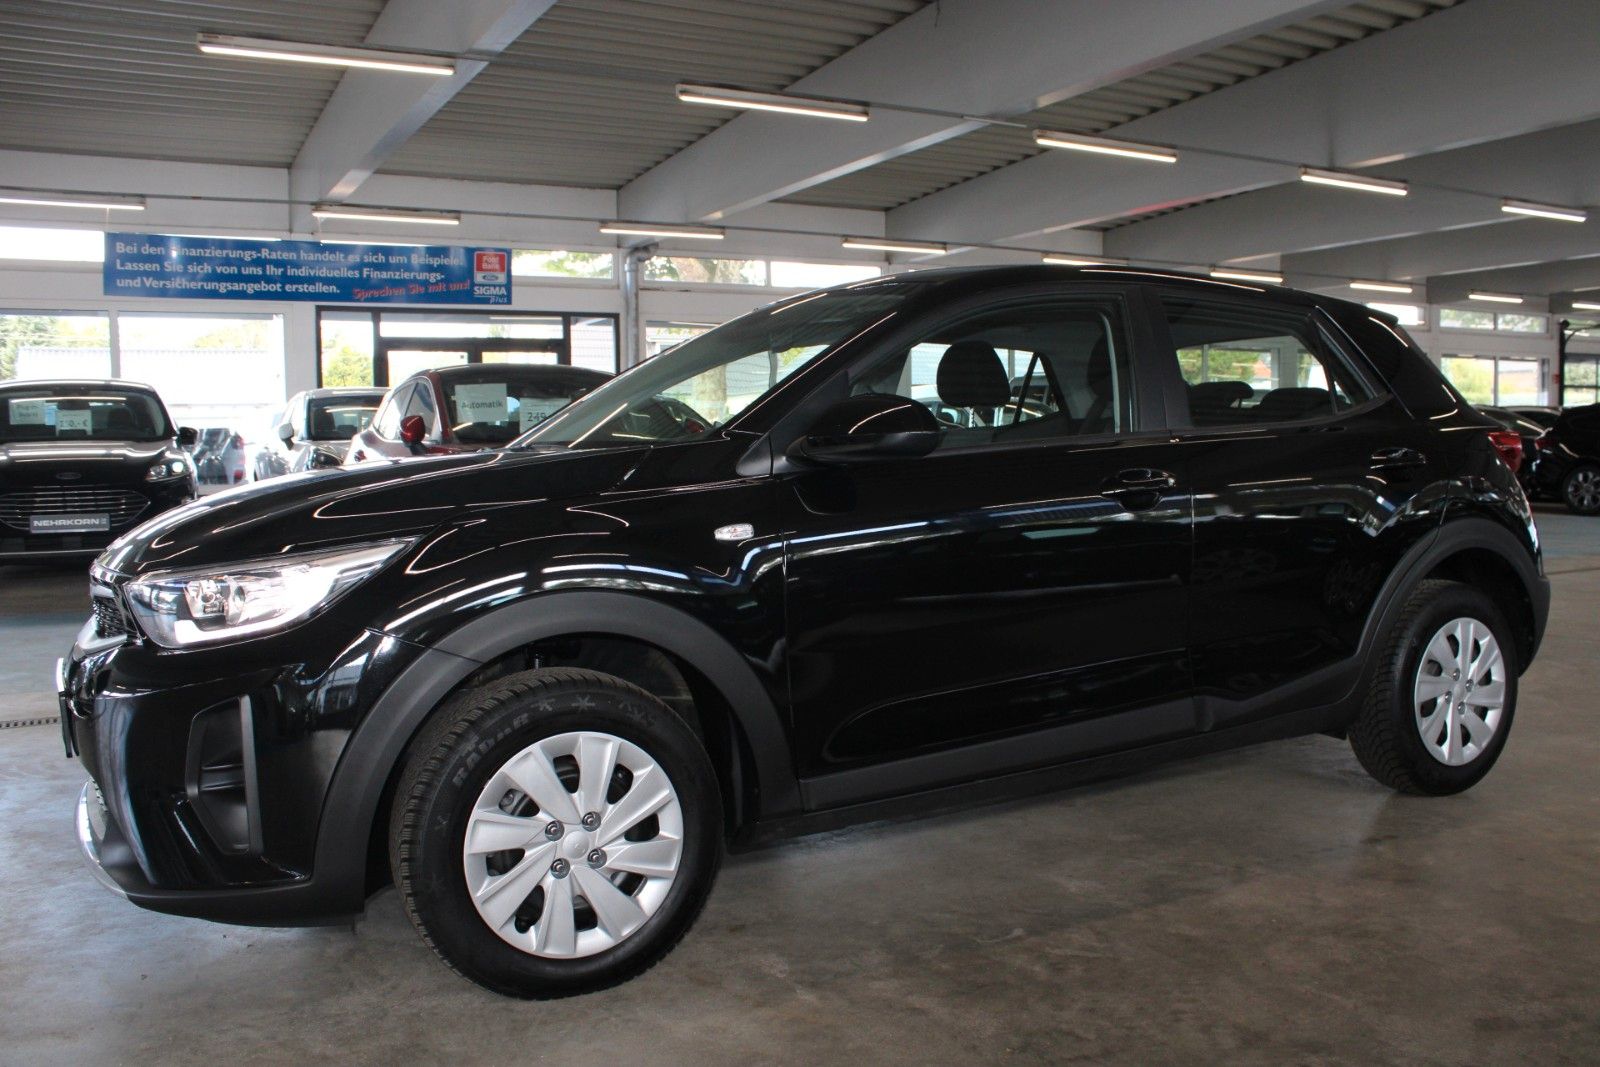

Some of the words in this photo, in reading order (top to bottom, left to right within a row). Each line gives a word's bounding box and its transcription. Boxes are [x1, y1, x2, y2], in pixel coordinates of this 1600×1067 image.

[116, 242, 137, 254] Bei
[141, 244, 165, 255] den
[170, 246, 296, 262] inanzierungs-Raten
[300, 250, 345, 262] handelt
[347, 254, 360, 263] es
[363, 252, 386, 264] sich
[389, 255, 408, 264] um
[116, 259, 160, 272] Lassen
[164, 260, 184, 273] Sie
[187, 262, 211, 274] sich
[215, 266, 238, 275] von
[241, 266, 262, 275] uns
[266, 264, 284, 276] Ihr
[287, 265, 360, 279] individuelles
[362, 267, 445, 283] Finanzierungs-
[116, 277, 141, 288] und
[143, 277, 282, 294] Versicherungsangebot
[284, 281, 341, 294] erstellen.
[352, 286, 406, 301] Sprechen
[408, 283, 425, 295] Sie
[428, 281, 446, 293] mit
[449, 279, 471, 292] uns!
[473, 286, 507, 296] SIGMA
[489, 295, 508, 304] plus
[461, 400, 504, 409] Automatik
[33, 518, 100, 527] NEHRKORN
